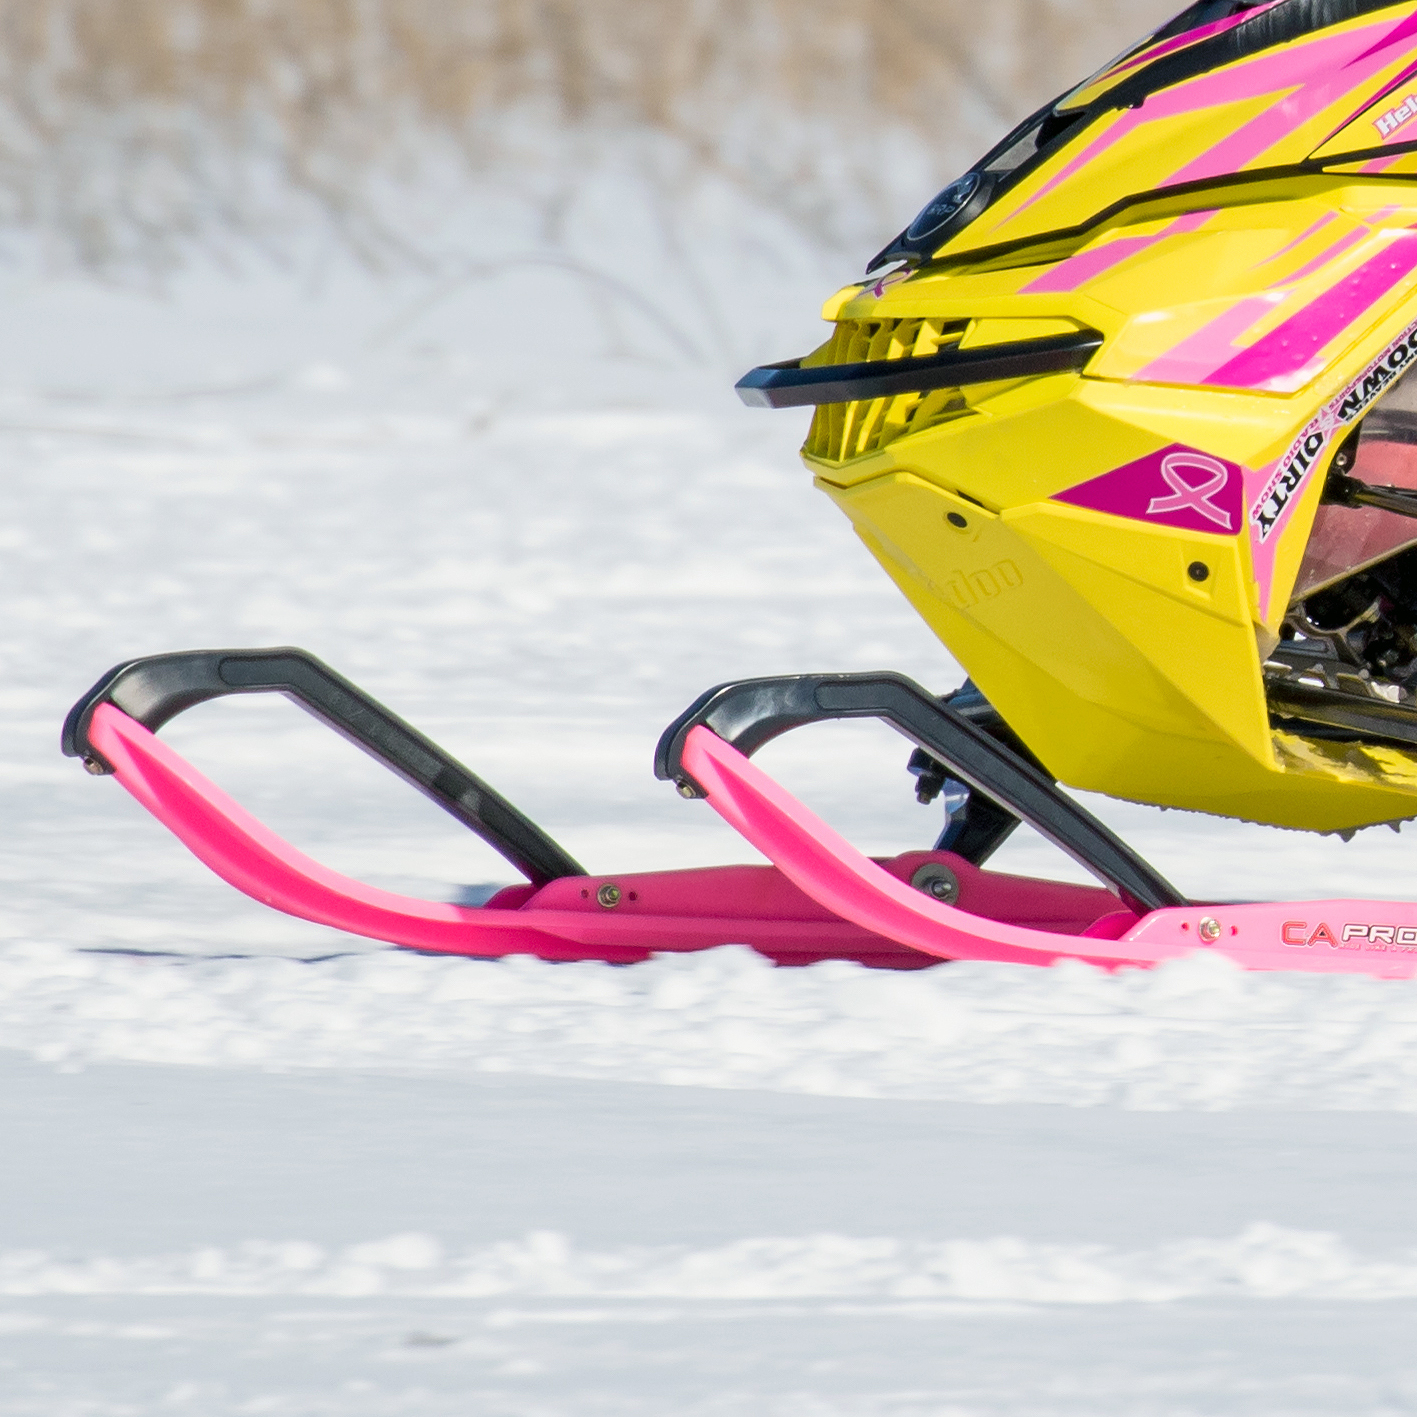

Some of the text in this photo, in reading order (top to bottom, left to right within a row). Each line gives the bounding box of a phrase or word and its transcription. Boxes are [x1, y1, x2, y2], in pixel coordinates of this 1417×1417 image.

[1283, 418, 1319, 467] RADIO
[1252, 467, 1283, 518] SHOW
[1257, 432, 1324, 539] DIRTY
